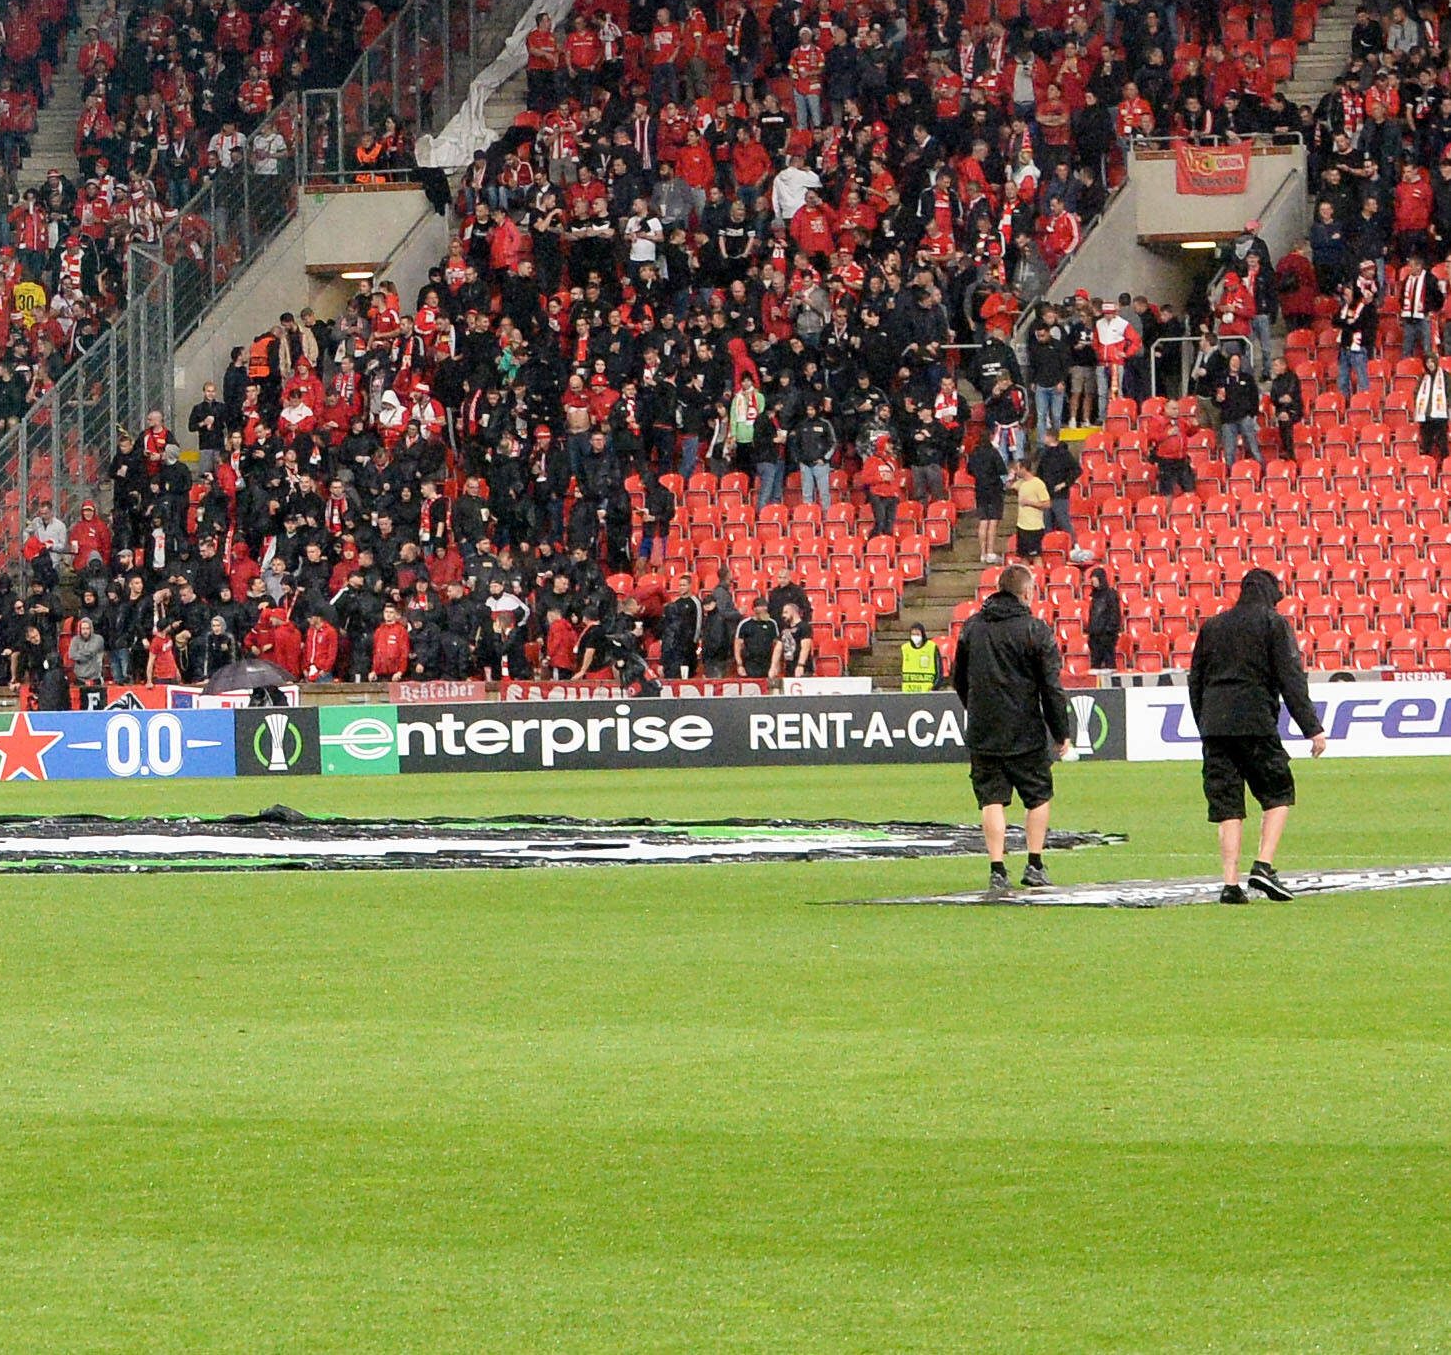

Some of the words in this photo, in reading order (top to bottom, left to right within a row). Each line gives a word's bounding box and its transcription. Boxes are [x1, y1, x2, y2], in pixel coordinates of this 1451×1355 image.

[18, 294, 34, 311] 30
[320, 704, 714, 767] enterprise
[749, 709, 968, 750] RENT-A-CA
